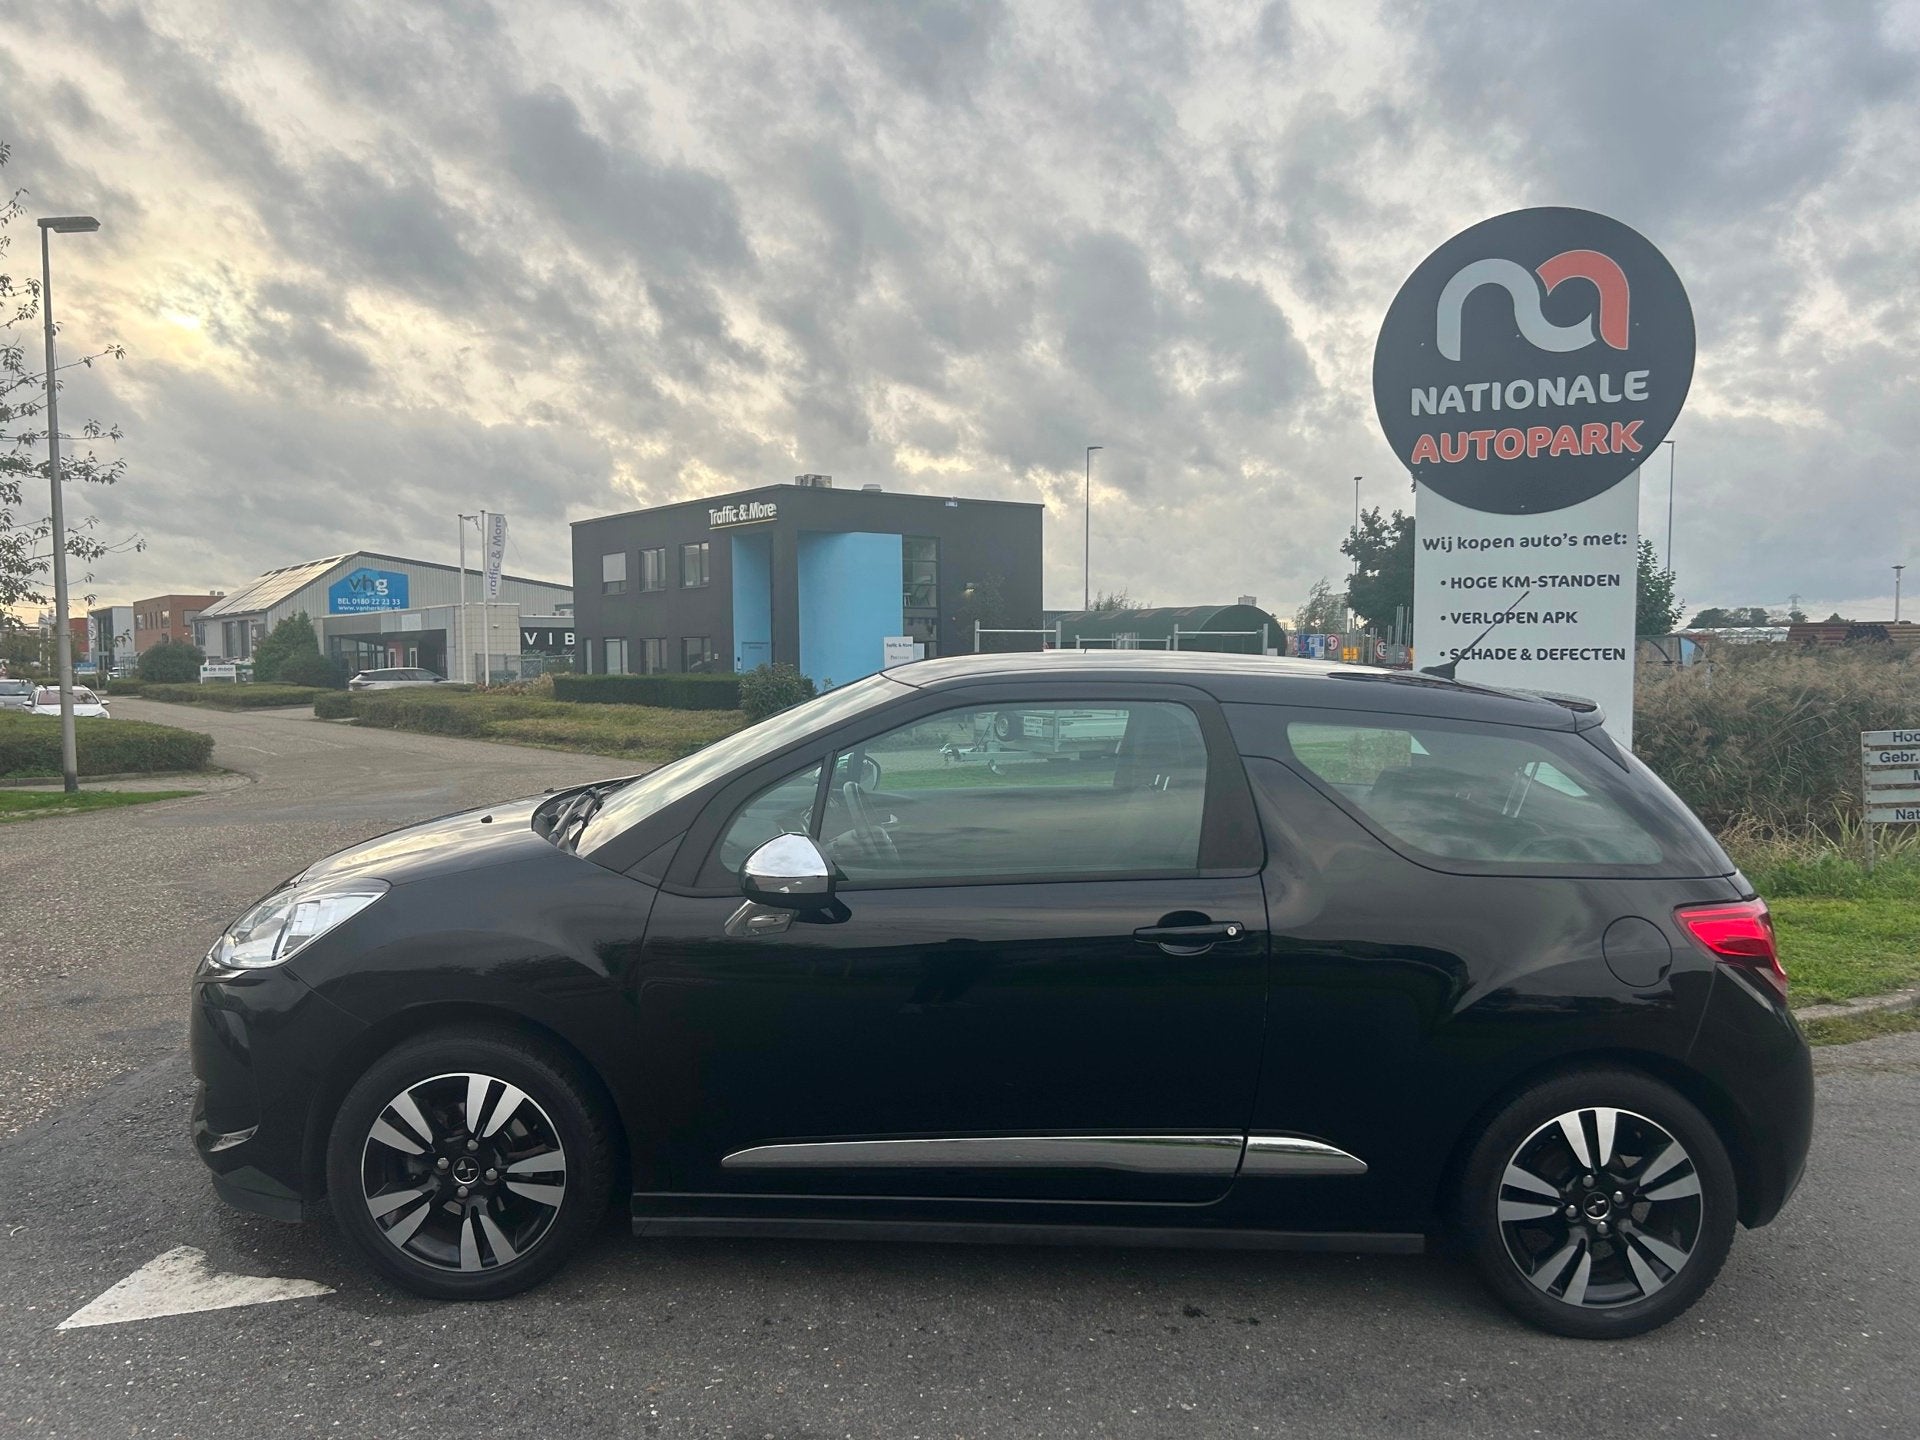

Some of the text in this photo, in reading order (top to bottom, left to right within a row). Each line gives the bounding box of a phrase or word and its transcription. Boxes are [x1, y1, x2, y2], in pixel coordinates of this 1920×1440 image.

[1411, 370, 1650, 416] NATIONALE
[1411, 420, 1645, 464] AUTOPARK
[709, 502, 777, 525] Traffic & More
[1422, 531, 1628, 553] Wij kopen auto's met:
[348, 574, 389, 595] vhg
[1451, 574, 1620, 589] HOGE KM-STANDEN
[337, 597, 351, 605] BEL
[1451, 611, 1578, 624] VERLOPEN APK
[1450, 647, 1625, 660] SCHADE & DEFECTEN
[1880, 751, 1919, 763] Gebr.
